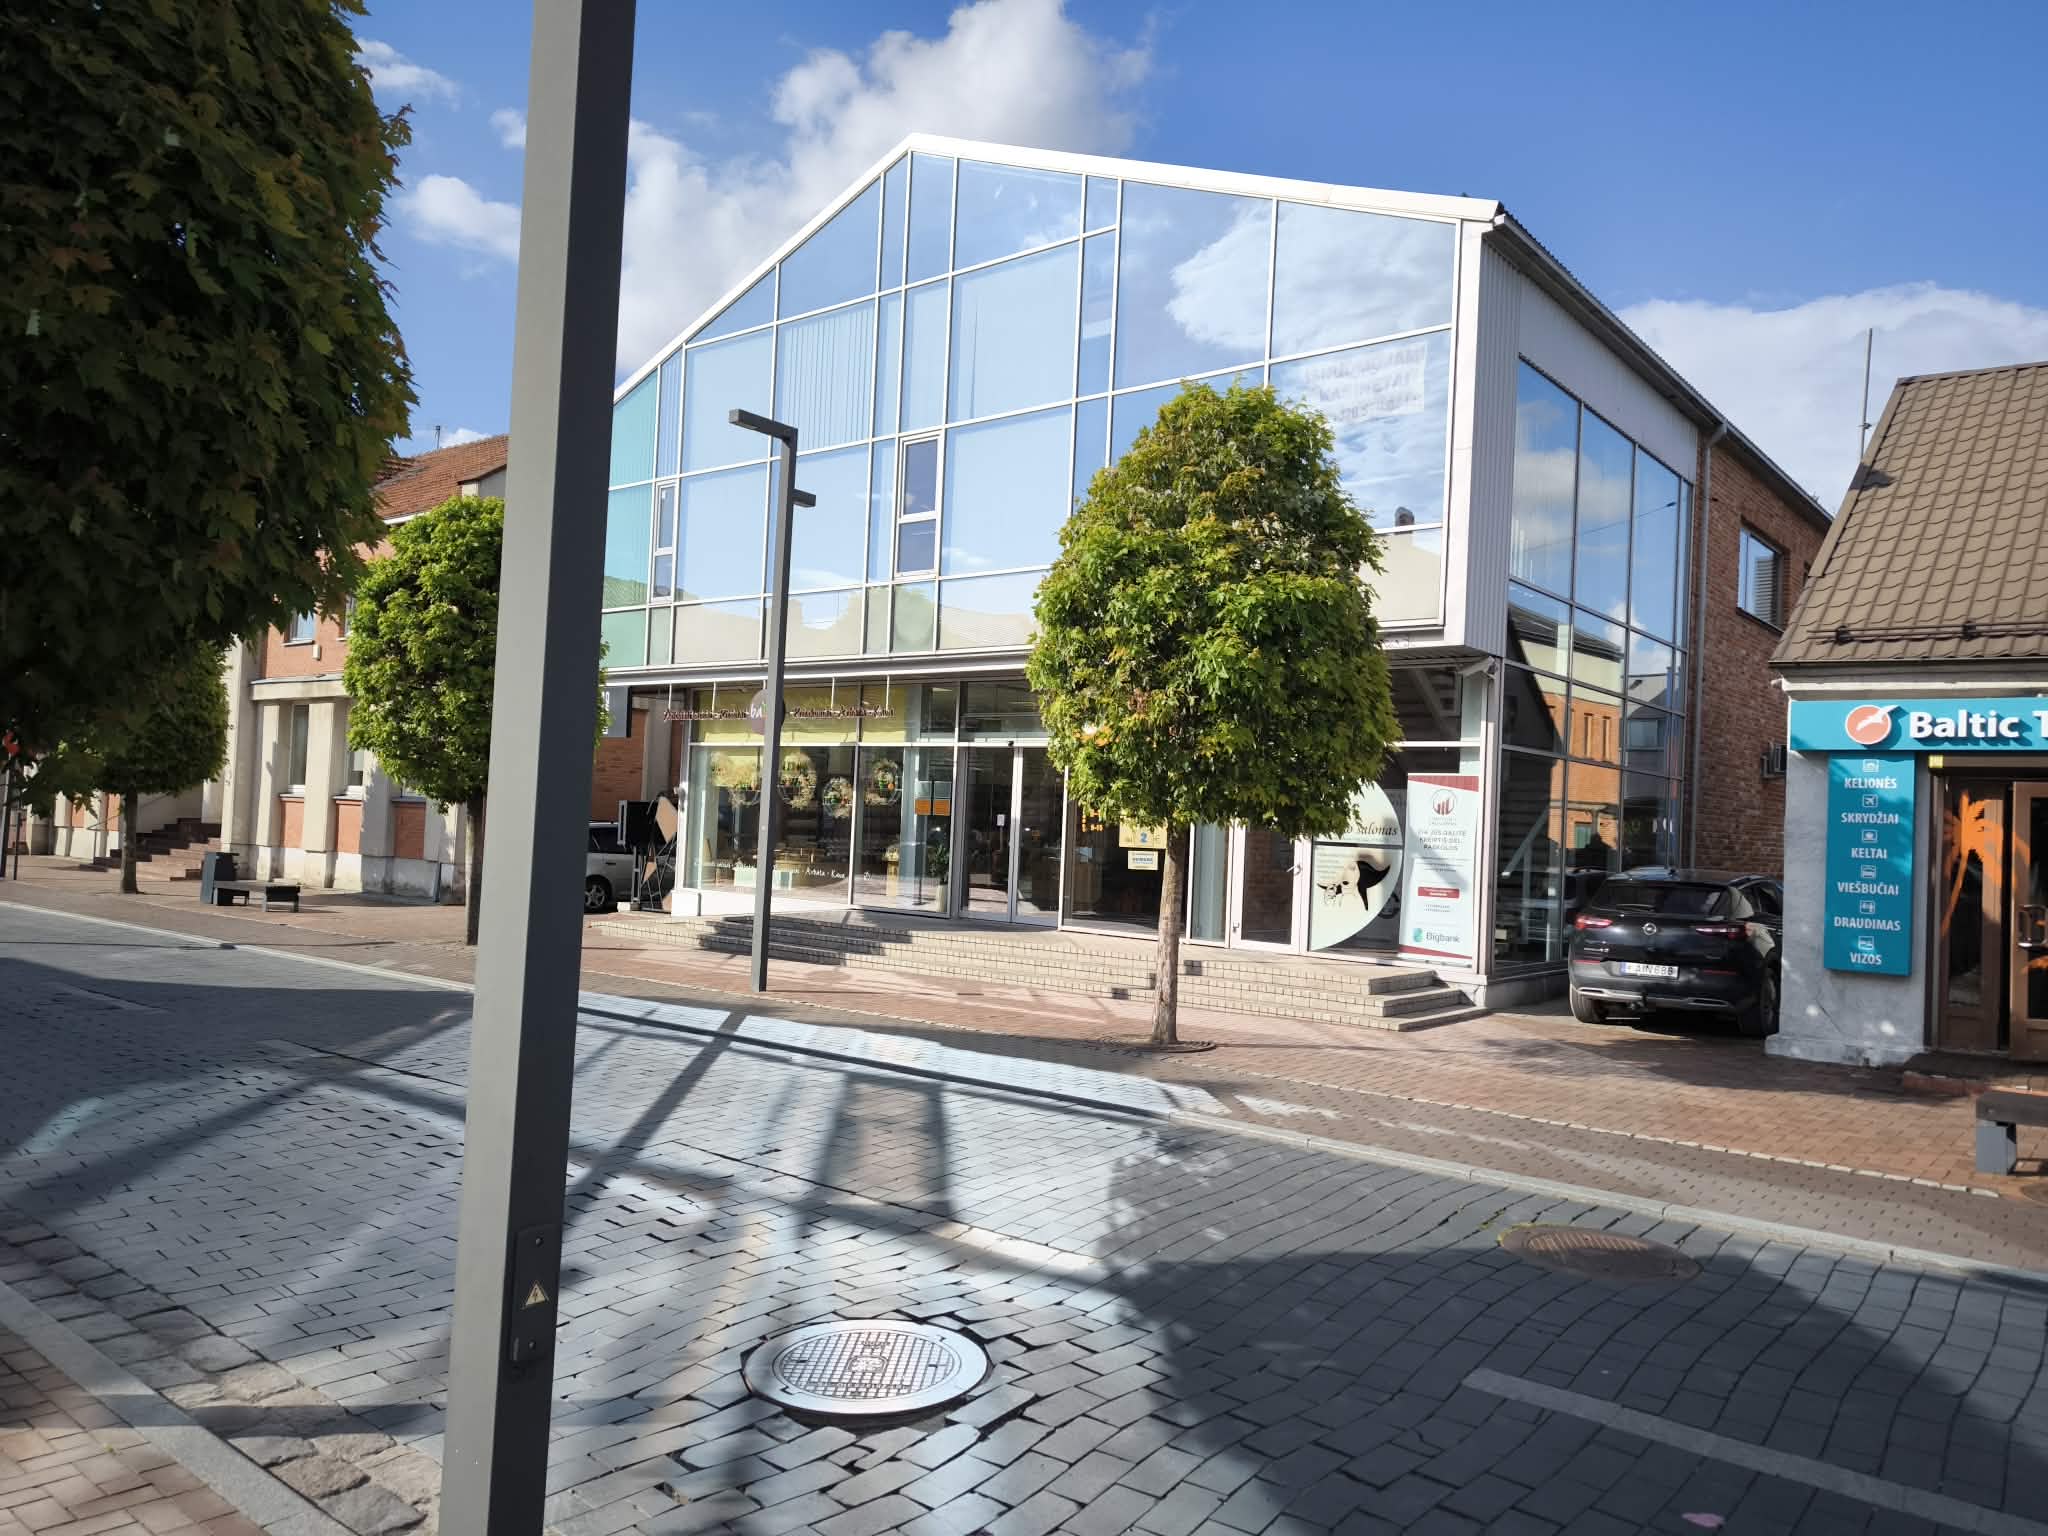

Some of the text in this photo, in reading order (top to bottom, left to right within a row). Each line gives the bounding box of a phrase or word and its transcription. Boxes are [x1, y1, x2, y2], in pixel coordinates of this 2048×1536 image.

[1909, 709, 2019, 738] Baltic
[1844, 775, 1897, 790] KELIONĖS
[1841, 810, 1899, 825] SKRYDŽIAI
[1850, 847, 1888, 860] KELTAI
[1837, 881, 1900, 897] VIEŠBUČIAI
[1833, 916, 1901, 932] DRAUDIMAS
[1426, 931, 1461, 943] Bigbank
[1850, 952, 1883, 966] VIZOS
